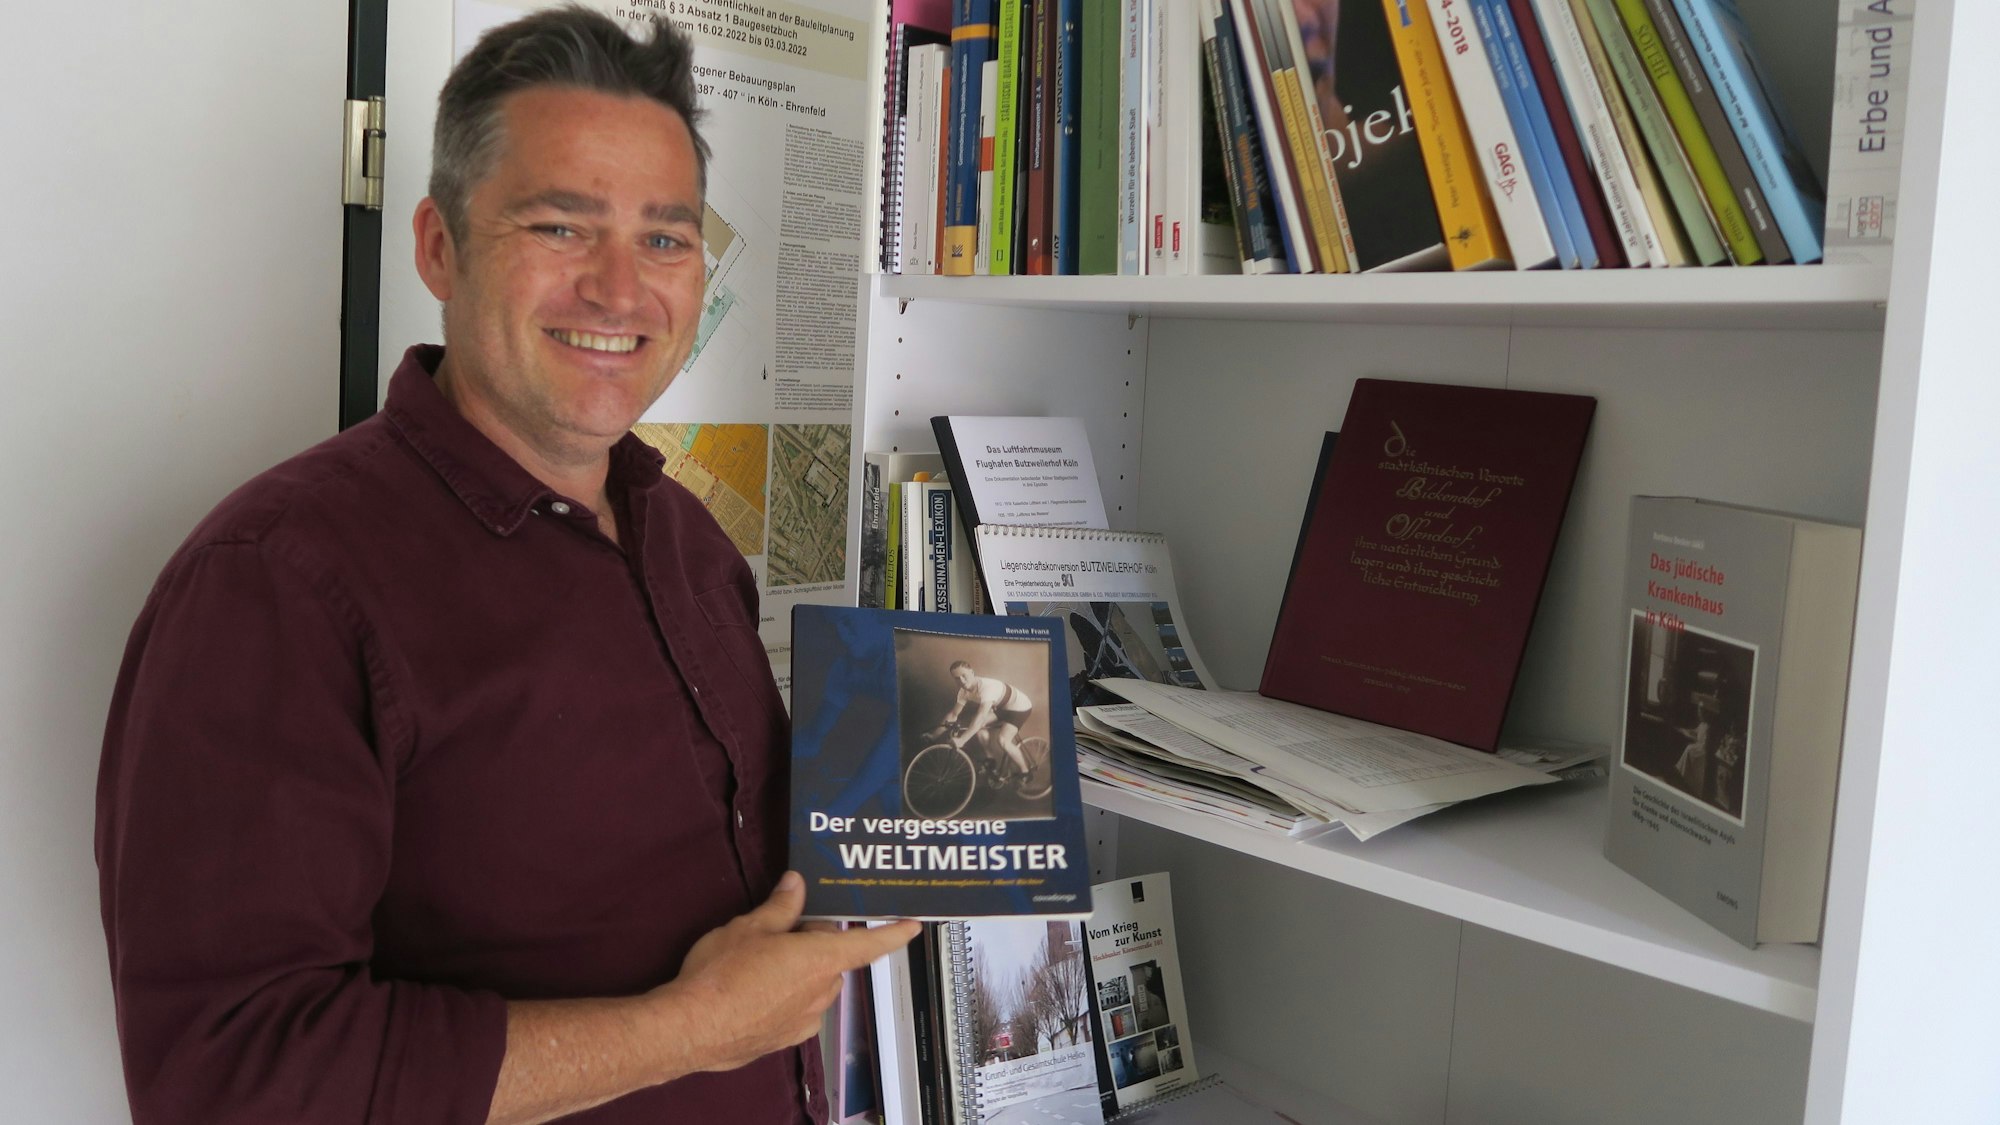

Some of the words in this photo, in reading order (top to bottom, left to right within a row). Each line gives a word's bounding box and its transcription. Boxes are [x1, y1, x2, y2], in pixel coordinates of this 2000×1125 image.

[628, 8, 646, 21] der
[697, 22, 747, 42] 16.02.2022
[749, 34, 762, 45] bis
[764, 37, 807, 56] 03.03.2022
[670, 2, 675, 14] §
[679, 4, 685, 14] 3
[687, 5, 721, 21] Absatz
[724, 13, 730, 23] 1
[732, 15, 798, 39] Baugesetzbuch
[767, 11, 777, 19] an
[779, 11, 793, 23] der
[794, 15, 855, 42] Bauleitplanung
[1634, 22, 1670, 81] HELIOS
[1866, 28, 1892, 79] und
[728, 70, 796, 93] Bebauungsplan
[697, 84, 715, 96] 387
[723, 87, 738, 100] 407
[747, 93, 755, 104] in
[758, 96, 778, 108] Köln
[786, 102, 826, 117] Ehrenfeld
[1859, 90, 1889, 152] Erbe
[1494, 142, 1517, 178] GAG
[1584, 122, 1615, 180] Philharmonie
[1127, 191, 1135, 224] Wurzeln
[1607, 180, 1625, 209] Kölner
[1617, 208, 1634, 235] Jahre
[986, 445, 1000, 454] Das
[1003, 445, 1062, 454] Luftfahrtmuseum
[1384, 420, 1416, 457] Die
[976, 459, 1013, 469] Flughafen
[1015, 459, 1062, 467] Butzweilerhof
[1063, 459, 1078, 467] Köln
[1378, 460, 1474, 480] stadtkölnischen
[1479, 468, 1525, 486] Vororte
[1396, 477, 1502, 508] Bickendorf
[872, 487, 880, 530] Ehrenfeld
[1424, 506, 1456, 519] und
[1355, 536, 1377, 550] ihre
[1381, 540, 1453, 562] natürlichen
[887, 549, 895, 588] HELIOS
[1000, 560, 1080, 572] Liegenschaftskonversion
[1080, 561, 1143, 573] BUTZWEILERHOF
[1350, 552, 1384, 570] lagen
[1387, 560, 1411, 572] und
[1414, 564, 1439, 577] ihre
[1362, 571, 1392, 586] liche
[1651, 553, 1671, 572] Das
[1673, 558, 1724, 586] jüdische
[1015, 579, 1053, 588] Projektentwicklung
[1648, 580, 1723, 615] Krankenhaus
[1005, 627, 1029, 635] Renate
[1031, 628, 1050, 636] Franz
[1646, 605, 1655, 624] in
[1660, 611, 1685, 633] Köln
[809, 812, 855, 833] Der
[863, 817, 1007, 840] vergessene
[839, 844, 1068, 870] WELTMEISTER
[1089, 928, 1110, 941] Vom
[1112, 920, 1139, 936] Krieg
[1115, 937, 1131, 947] zur
[1133, 927, 1162, 943] Kunst
[985, 1069, 1008, 1081] Grund-
[1010, 1066, 1022, 1075] und
[1023, 1055, 1066, 1072] Gesamtschule
[1067, 1051, 1085, 1061] Helios
